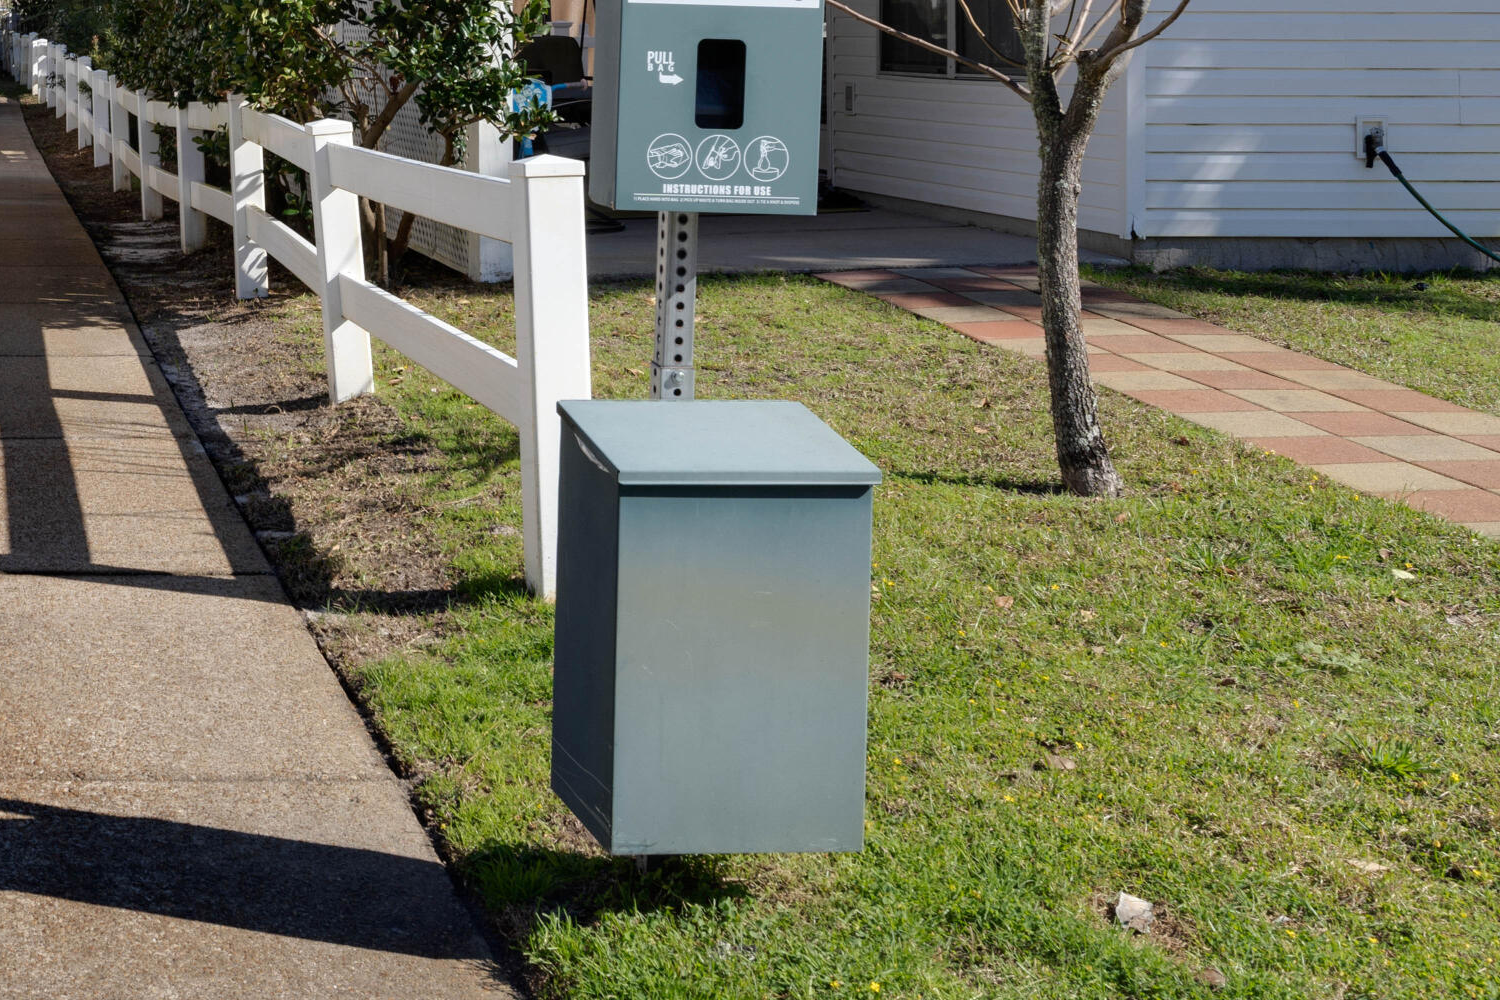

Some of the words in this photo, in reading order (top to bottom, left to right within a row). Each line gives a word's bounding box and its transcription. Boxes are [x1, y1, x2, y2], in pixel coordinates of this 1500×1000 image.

[647, 51, 675, 64] PULL
[662, 183, 732, 196] INSTRUCTIONS
[733, 185, 751, 196] FOR
[753, 185, 772, 196] USE
